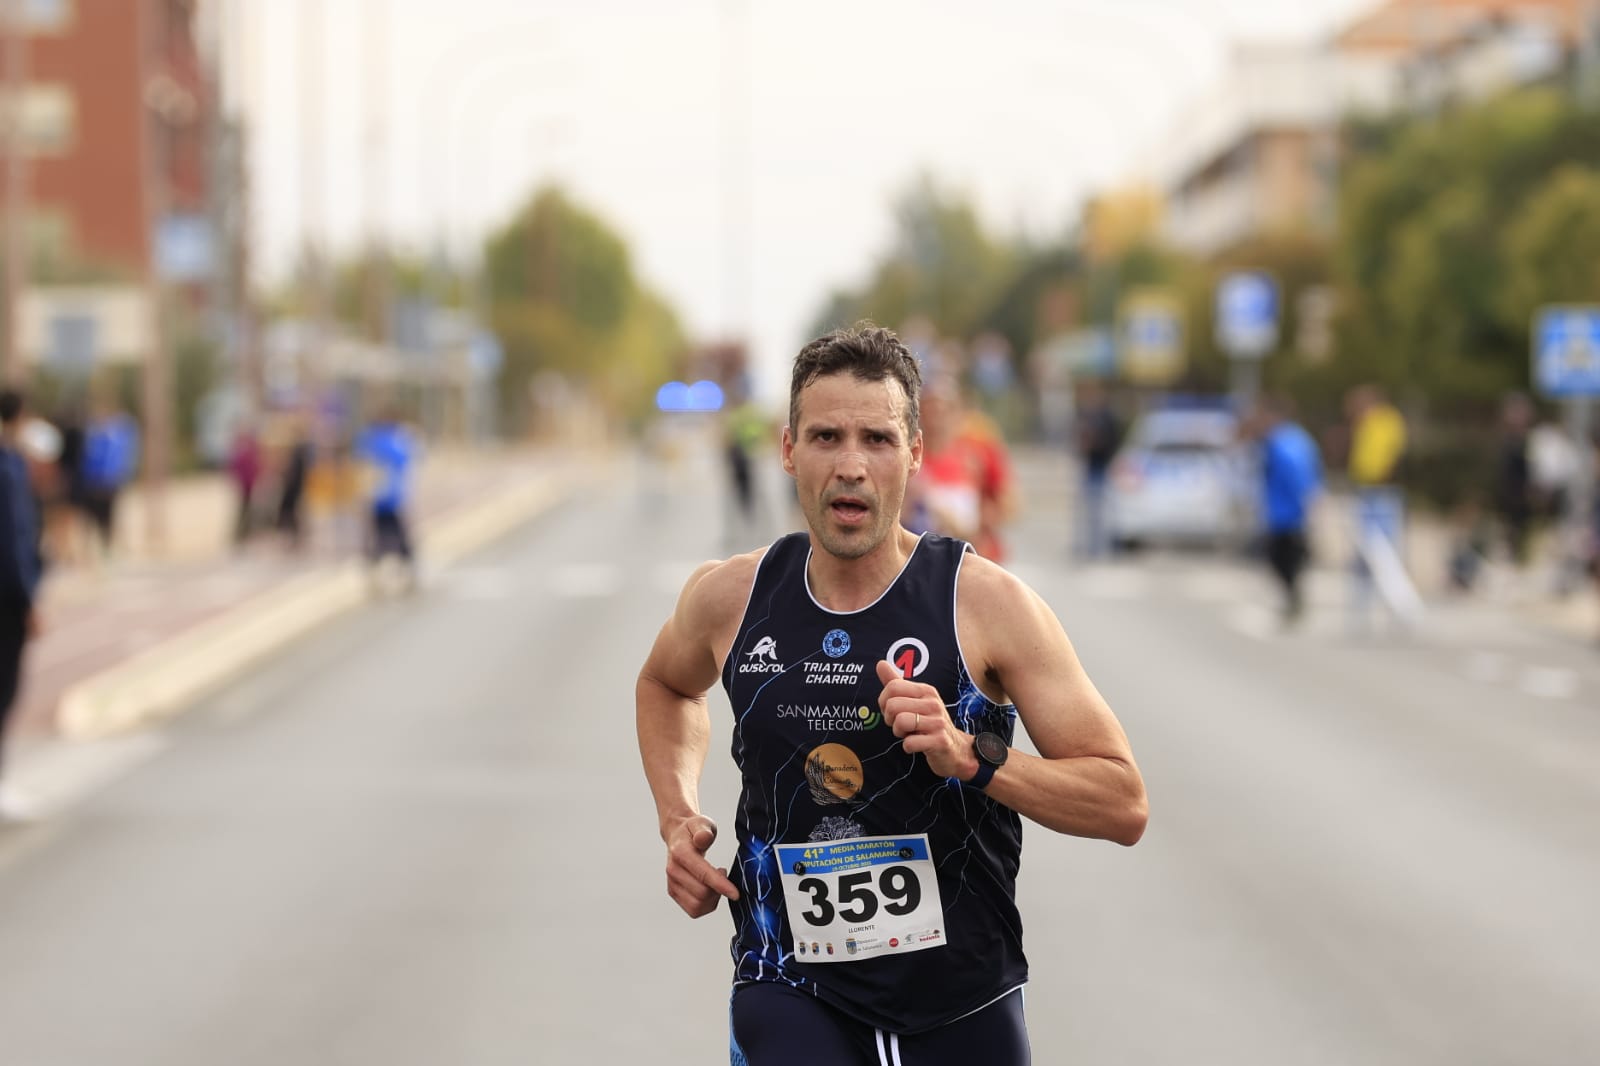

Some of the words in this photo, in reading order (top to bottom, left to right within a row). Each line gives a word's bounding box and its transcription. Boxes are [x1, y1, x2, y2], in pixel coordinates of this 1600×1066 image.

[803, 662, 864, 673] TRIATLÓN
[806, 674, 858, 685] CHARRO
[807, 719, 864, 731] TELECOM
[830, 843, 855, 855] MEDIA
[856, 840, 895, 852] MARATÓN
[844, 855, 854, 864] DE
[798, 865, 921, 926] 359
[848, 924, 875, 934] LLORENTE
